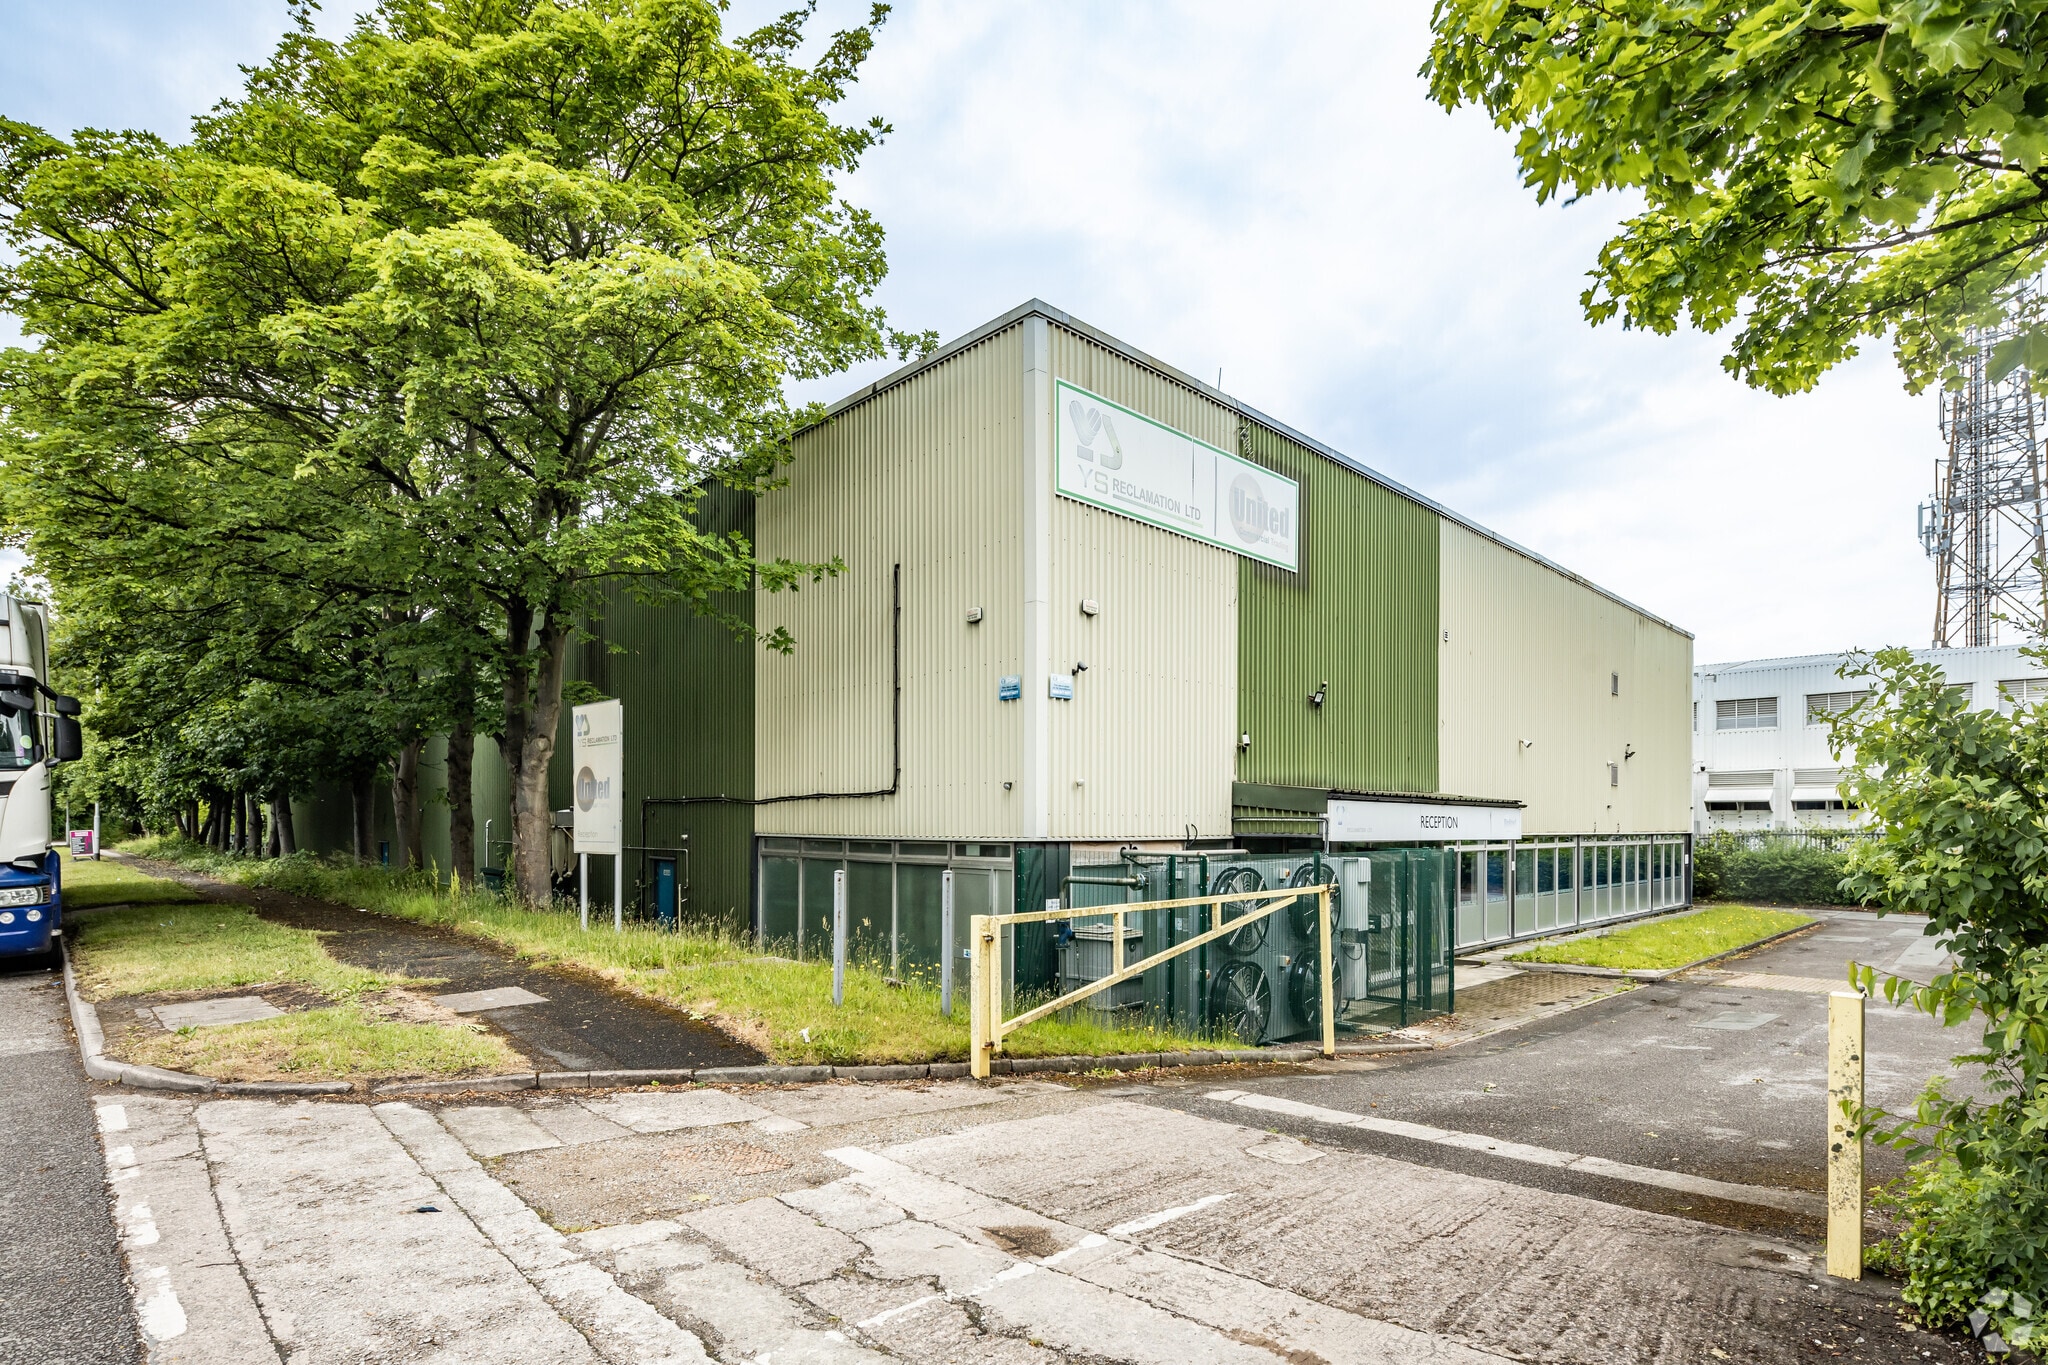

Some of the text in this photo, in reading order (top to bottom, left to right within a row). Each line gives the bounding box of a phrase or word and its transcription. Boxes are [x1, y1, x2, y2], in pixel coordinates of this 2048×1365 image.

[1112, 478, 1180, 514] RECLAMATION
[1185, 504, 1201, 520] LTD
[1233, 486, 1289, 539] United
[1420, 815, 1458, 829] RECEPTION
